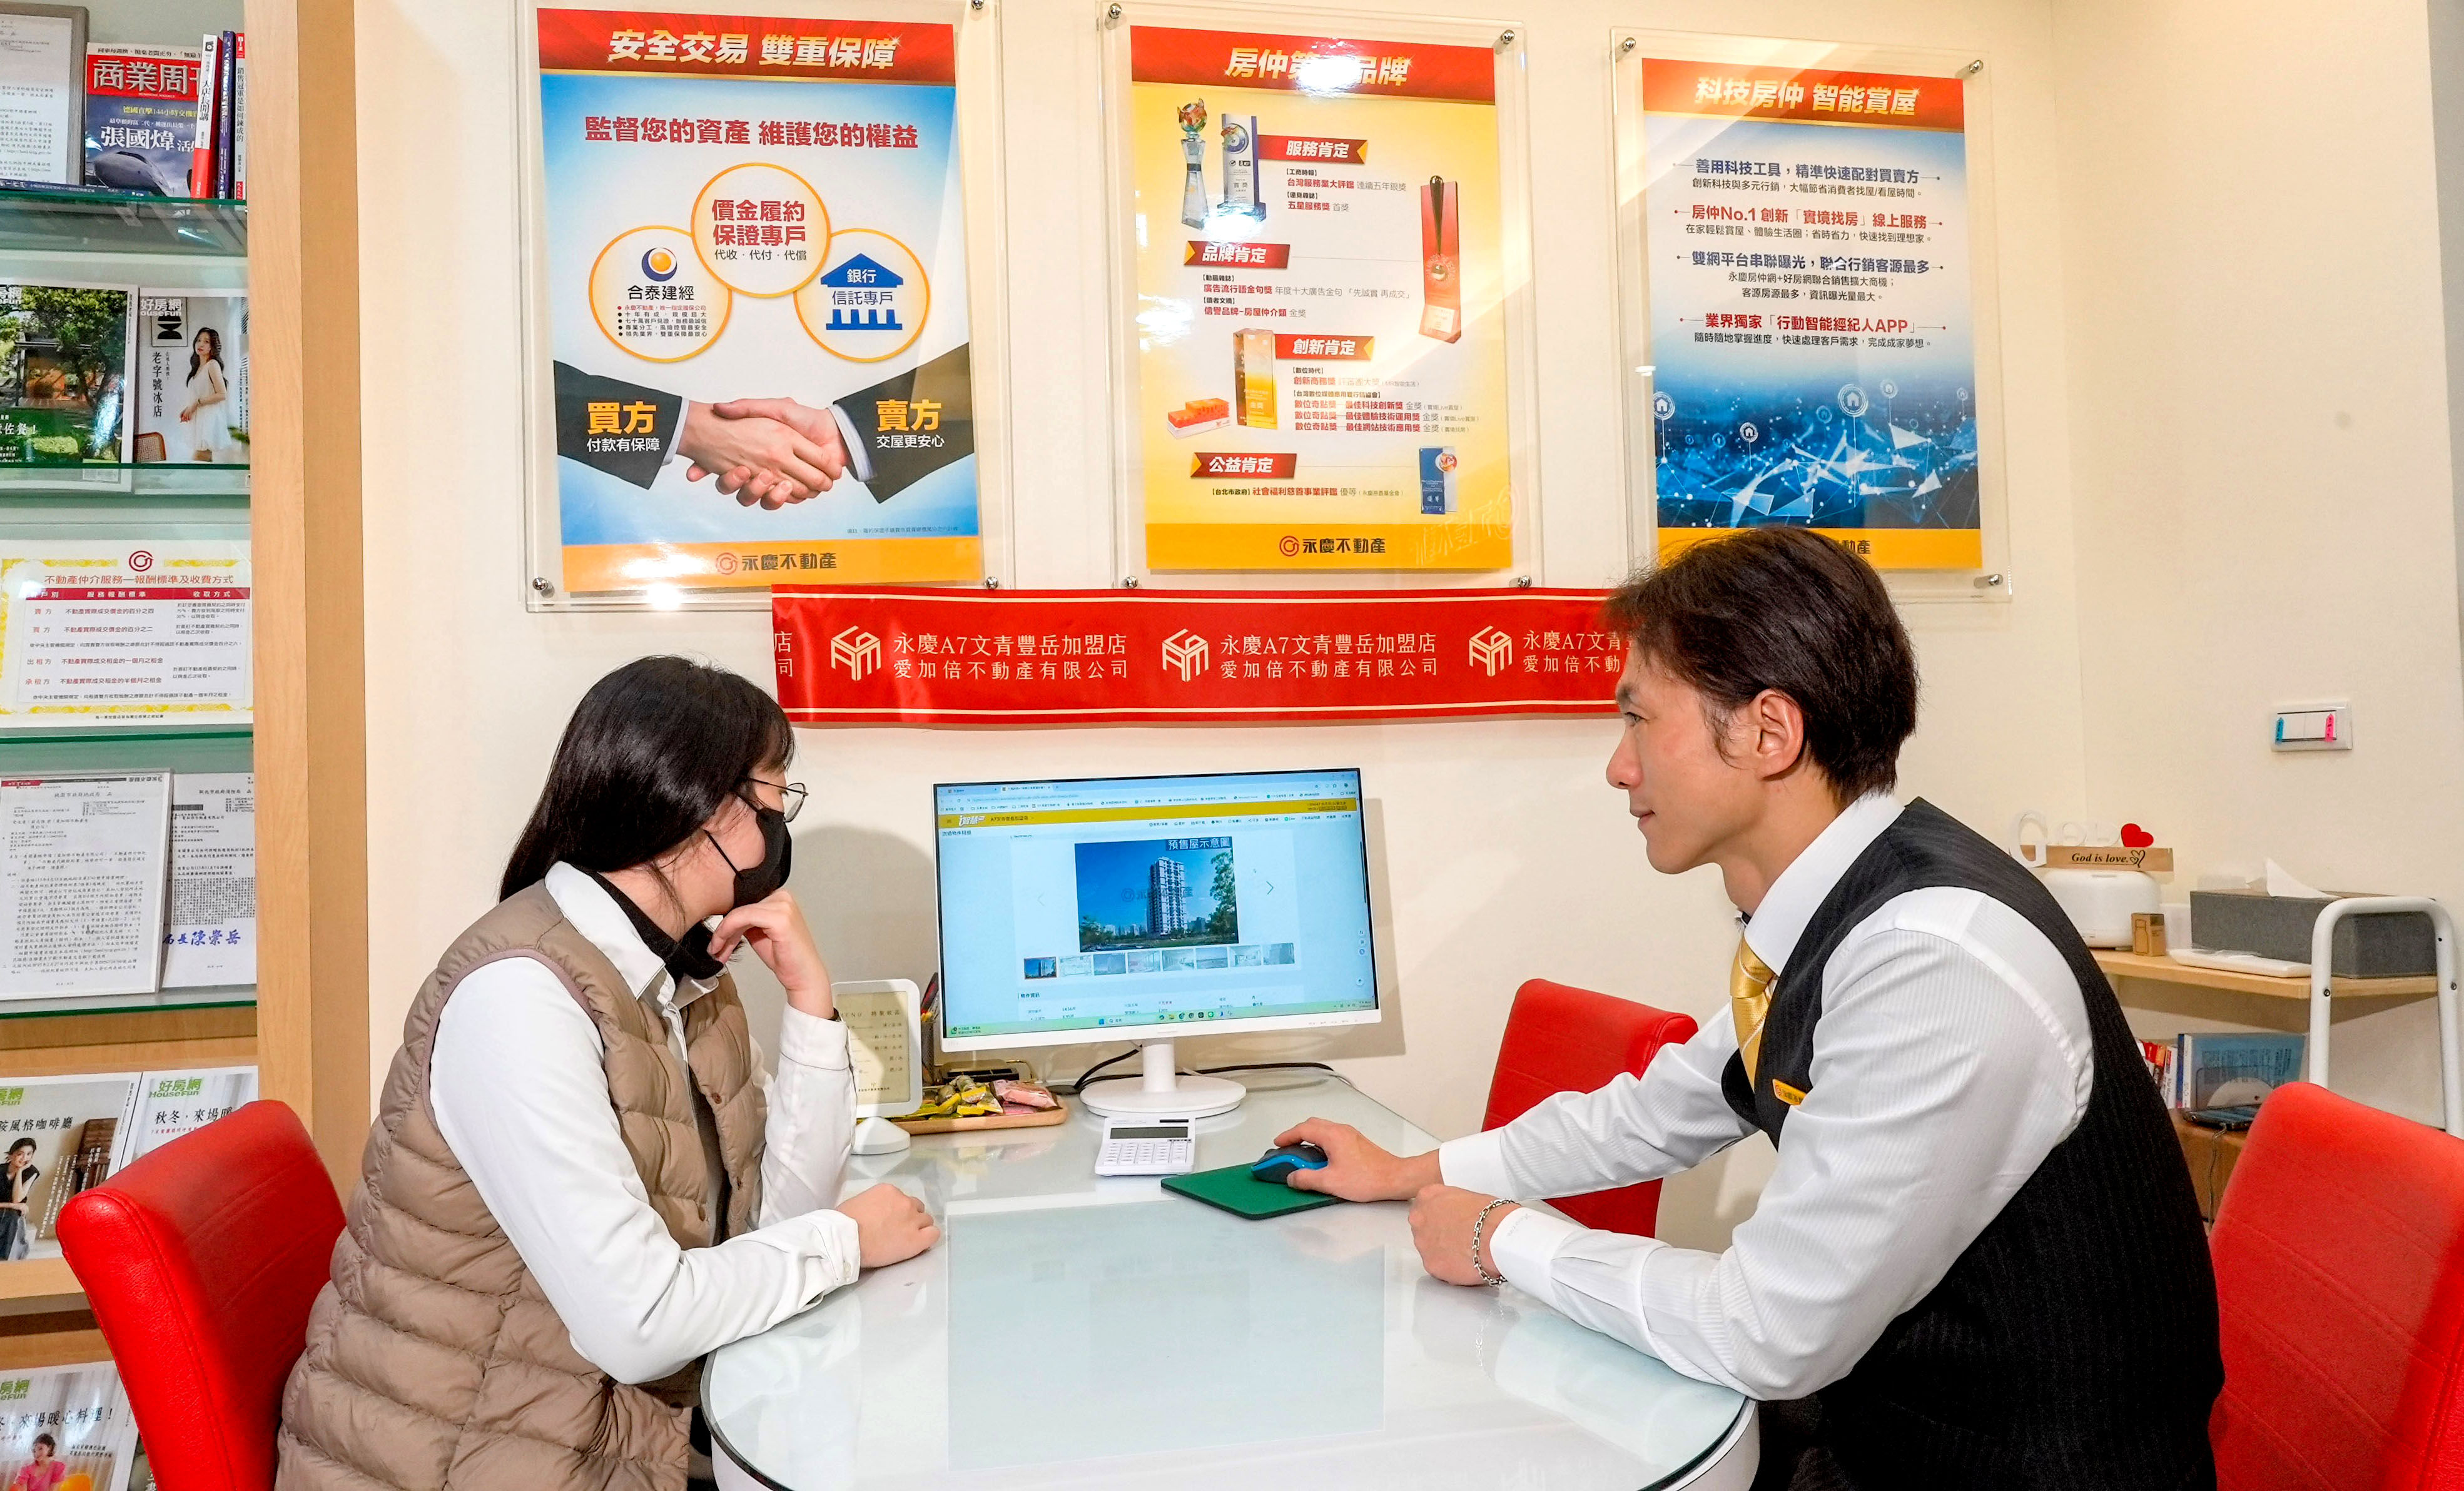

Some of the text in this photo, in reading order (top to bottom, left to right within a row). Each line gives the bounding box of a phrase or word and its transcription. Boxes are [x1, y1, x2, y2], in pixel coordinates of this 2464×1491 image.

[609, 29, 898, 69] 安全交易 雙重保障
[1225, 47, 1410, 86] 房仲第品牌
[1695, 76, 1919, 116] 科技房仲 智能賞屋
[100, 126, 175, 151] 張國煒
[585, 116, 918, 148] 監督您的資產 維護您的權益
[1286, 140, 1350, 158] 服務肯定
[1695, 158, 1919, 184] 善用科技工具，精準快速配對買賣方
[1287, 178, 1354, 189] 台灣服務業大評鑑
[711, 200, 804, 222] 價金履約
[1287, 201, 1349, 212] 五星服務獎 首獎
[1691, 204, 1757, 222] 房仲No.1
[712, 224, 806, 246] 保證專戶
[1202, 245, 1267, 263] 品牌肯定
[846, 268, 877, 283] 銀行
[627, 285, 694, 300] 合泰建經
[832, 291, 893, 305] 信託專戶
[1204, 284, 1272, 295] 廣告流行語金句獎
[140, 298, 182, 311] 好房網
[1289, 308, 1307, 318] 金獎
[1292, 338, 1356, 356] 創新肯定
[151, 351, 163, 417] 老字號冰店
[1294, 377, 1336, 386] 創新商務獎
[876, 398, 942, 432] 賣方
[1406, 402, 1422, 411] 金獎
[587, 401, 657, 435] 買方
[1422, 413, 1439, 422] 金獎
[1422, 423, 1440, 433] 金獎
[586, 437, 661, 452] 付款有保障
[876, 434, 945, 448] 交屋更安心
[1209, 456, 1274, 474] 公益肯定
[1252, 487, 1338, 496] 社會福利慈善事業評鑑
[1302, 538, 1386, 553] 永慶不動產
[741, 552, 838, 572] 永慶不動產
[86, 590, 146, 599] 服務報酬標準
[774, 631, 793, 653] 店
[893, 632, 1127, 656] 永慶A7文青豐岳加盟店
[1220, 632, 1437, 655] 永慶A7文青豐岳加盟店
[1523, 630, 1631, 651] 永慶A7文青
[778, 658, 793, 678] 司
[893, 659, 1127, 680] 愛加倍不動產有限公司
[1220, 657, 1437, 679] 愛加倍不動產有限公司
[1523, 654, 1621, 674] 愛加倍不動
[1168, 837, 1230, 851] 預售屋示意圖
[2071, 852, 2129, 864] God is love.
[159, 1077, 203, 1093] 好房網
